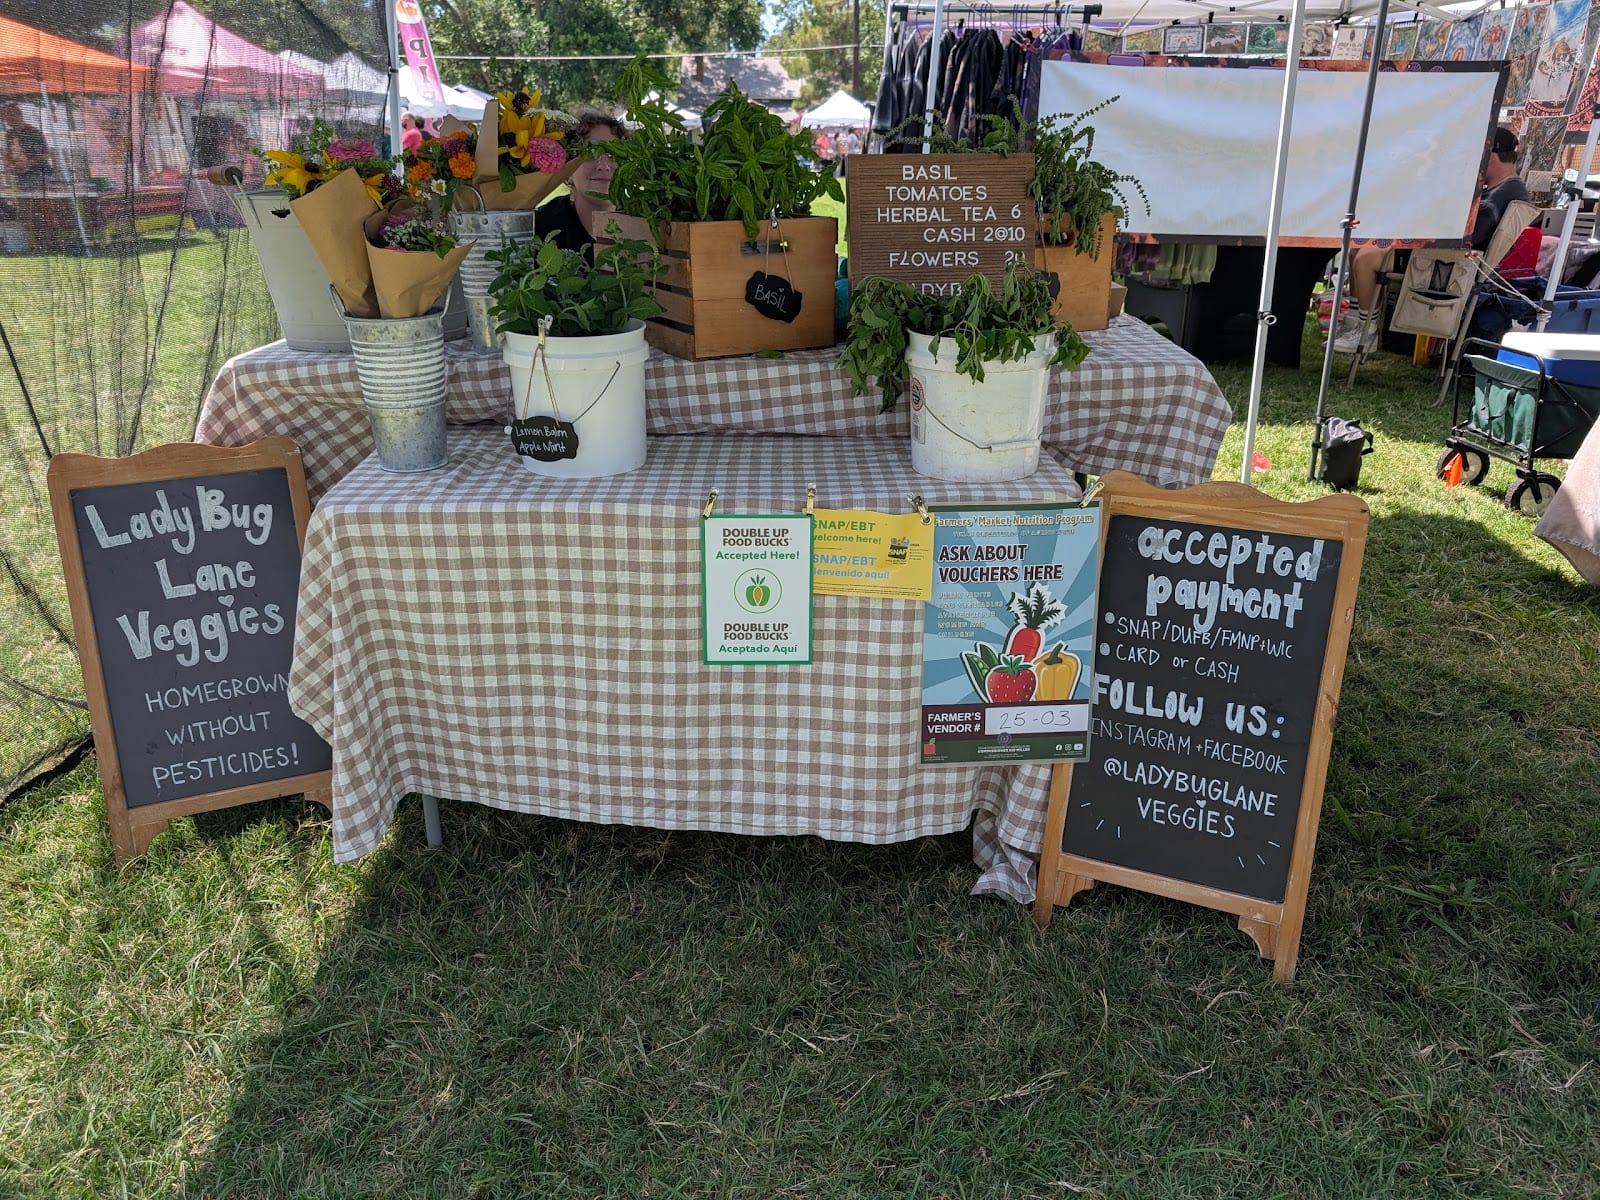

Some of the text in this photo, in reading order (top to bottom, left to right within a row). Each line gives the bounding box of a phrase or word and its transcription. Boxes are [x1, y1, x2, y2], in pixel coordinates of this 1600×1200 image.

[902, 165, 957, 181] BASIL
[885, 186, 987, 201] TOMATOES
[877, 204, 1021, 222] HERBAL TEA 6
[923, 226, 1025, 242] CASH 2@10
[889, 251, 979, 268] FLOWERS
[754, 284, 787, 314] BASIL
[515, 426, 543, 437] Lemon
[519, 441, 541, 455] Apple
[85, 486, 273, 554] Lady Bug
[813, 520, 876, 531] SNAP/EBT
[979, 516, 1011, 525] Market
[1013, 515, 1053, 525] Nutrition
[1056, 513, 1093, 525] Program
[722, 528, 789, 538] DOUBLE UP
[814, 533, 881, 545] elcome here!
[722, 538, 789, 546] FOOD BUCKS
[716, 551, 800, 561] Accepted Here!
[813, 554, 877, 566] SNAP/EBT
[939, 546, 969, 560] ASK
[974, 545, 1027, 560] ABOUT
[1137, 526, 1325, 584] accepted
[154, 558, 256, 599] Lane
[813, 568, 863, 577] ienvenido
[939, 564, 1063, 582] VOUCHERS HERE
[1146, 573, 1303, 633] payment
[116, 595, 285, 667] Veggies
[724, 623, 788, 632] DOUBLE UP
[724, 632, 788, 640] FOOD BUCKS
[719, 645, 769, 654] Aceptado
[1116, 643, 1240, 684] CARD or CASH
[145, 673, 290, 713] HOMEGROWN
[1093, 672, 1204, 727] FOLLOW
[928, 712, 982, 723] FARMER'S
[999, 710, 1071, 730] 25-03
[164, 711, 271, 746] WITHOUT
[927, 723, 981, 734] VENDOR #
[1091, 718, 1191, 756] INSTAGRAM
[152, 743, 300, 789] PESTICIDES!
[1104, 758, 1279, 816] @LADYBUGLANE
[1137, 797, 1235, 839] VEGGIES
